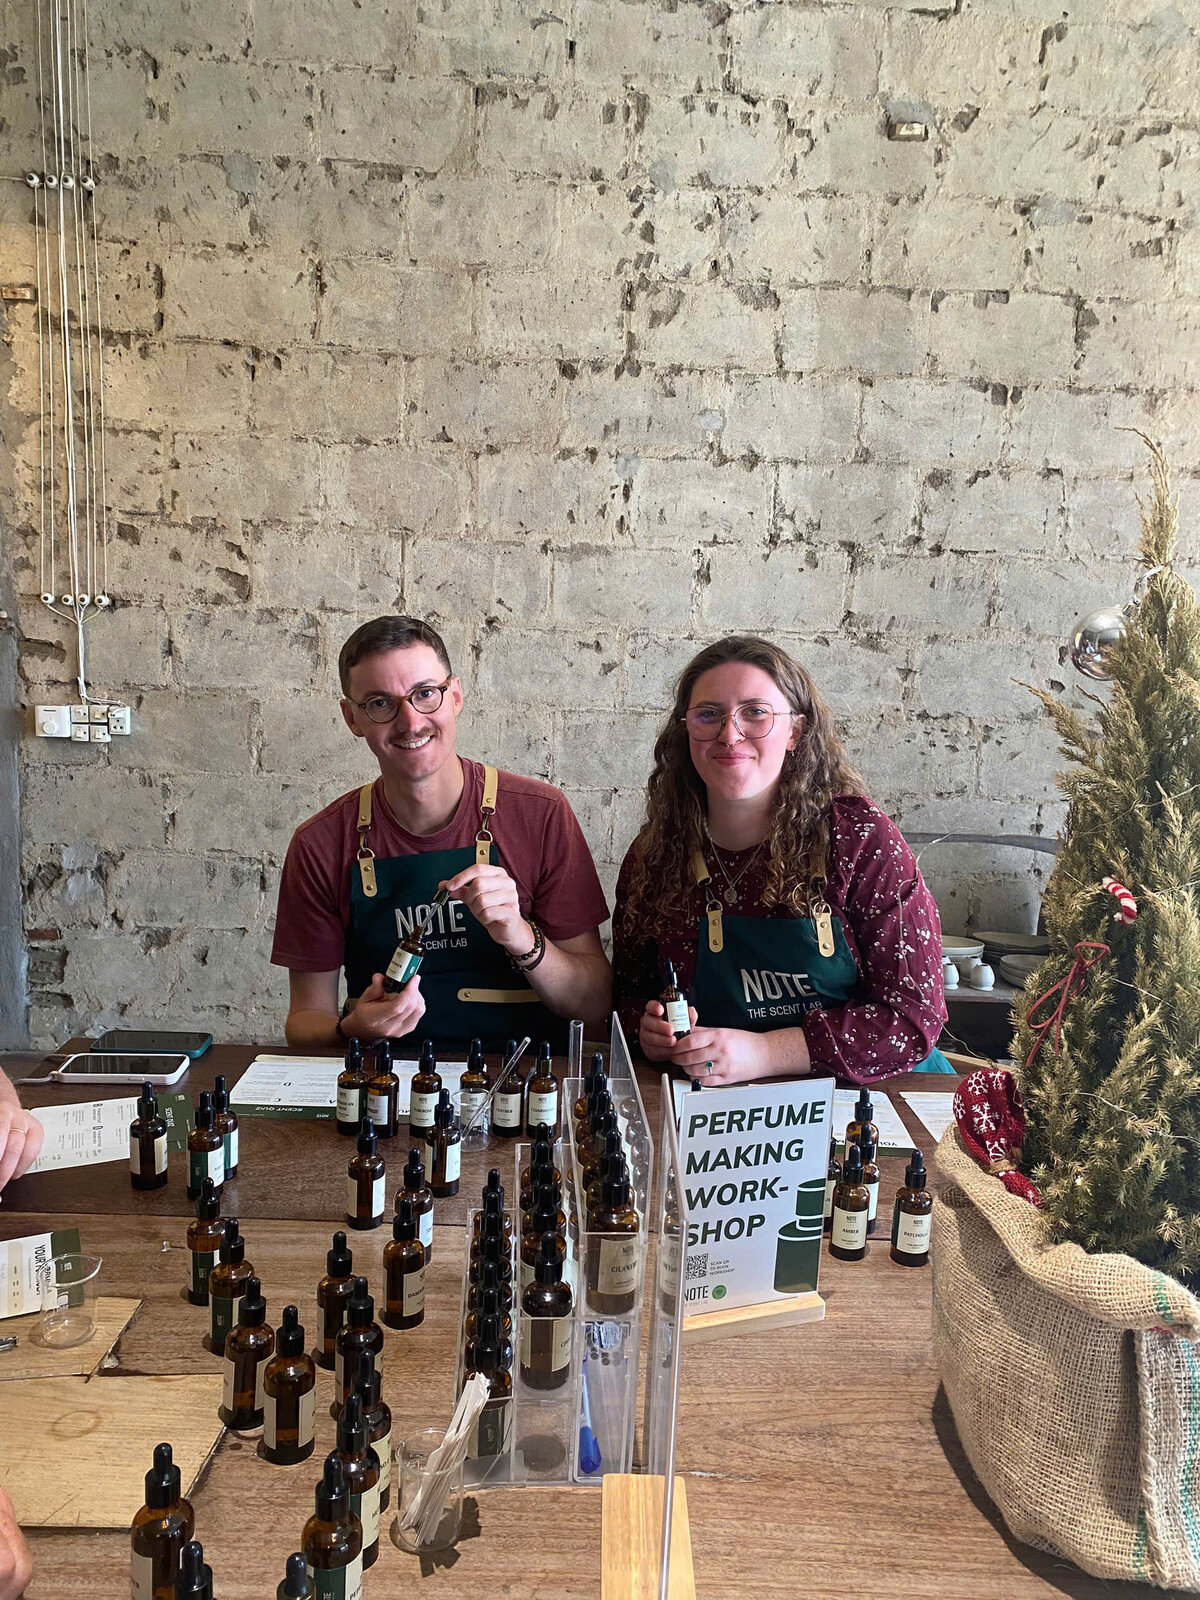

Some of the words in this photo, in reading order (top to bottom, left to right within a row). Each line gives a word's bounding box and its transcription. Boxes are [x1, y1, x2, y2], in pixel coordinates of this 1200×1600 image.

[394, 900, 467, 938] NOTE
[422, 939, 448, 951] CENT
[450, 937, 468, 948] LAB
[740, 968, 818, 1003] NOTE
[747, 1007, 768, 1019] THE
[769, 1003, 801, 1017] SCENT
[687, 1100, 826, 1138] PERFUME
[685, 1138, 804, 1175] MAKING
[684, 1176, 789, 1211] WORK-
[687, 1213, 766, 1247] SHOP
[34, 1244, 46, 1266] YOUR
[684, 1285, 709, 1301] NOTE
